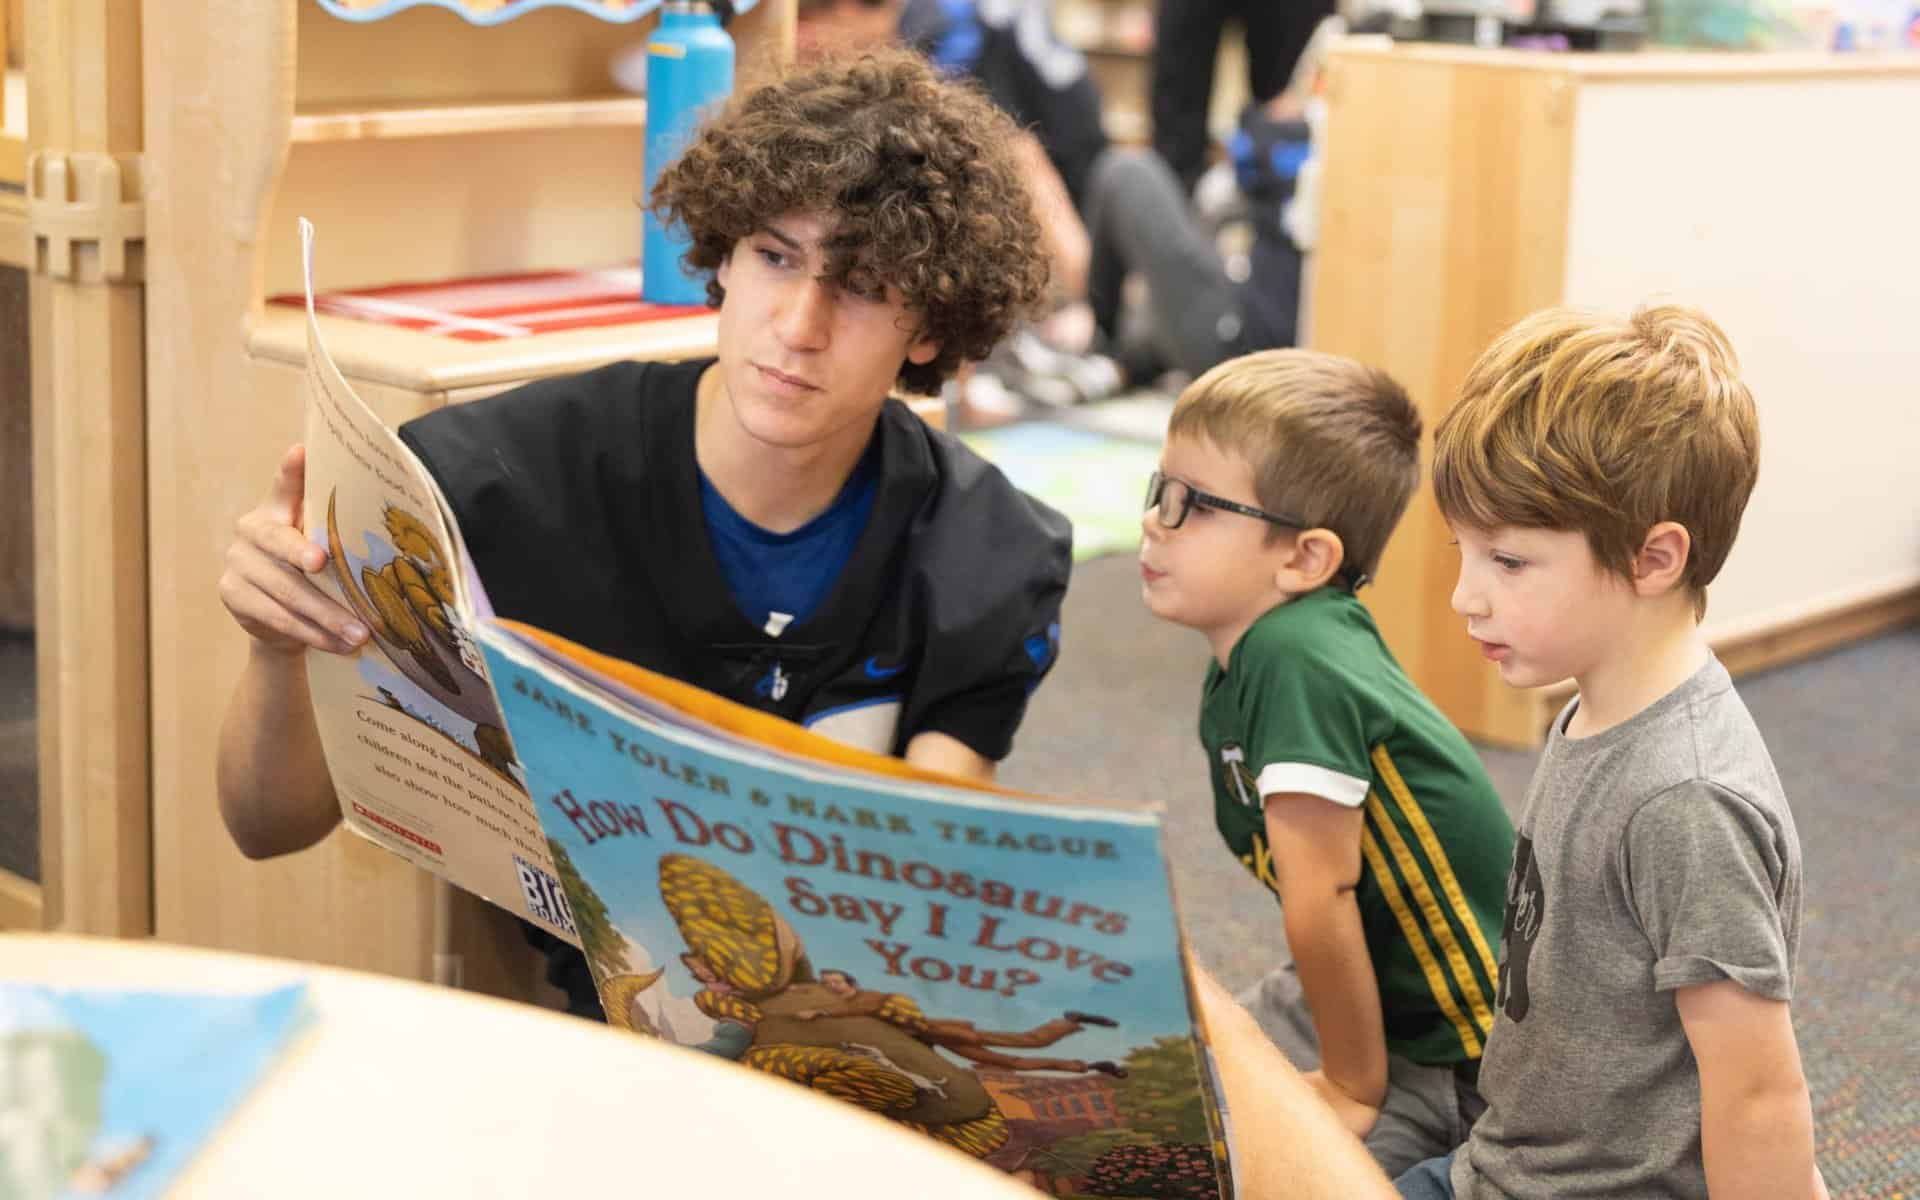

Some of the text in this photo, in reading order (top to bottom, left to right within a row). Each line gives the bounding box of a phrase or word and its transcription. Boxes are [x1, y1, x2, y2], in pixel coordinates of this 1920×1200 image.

[356, 710, 397, 735] Come
[400, 732, 438, 759] along
[440, 752, 464, 773] and
[466, 767, 493, 791] join
[496, 786, 517, 807] the
[356, 733, 412, 767] children
[415, 761, 440, 781] test
[442, 775, 464, 792] the
[466, 789, 521, 826] patience
[514, 675, 597, 736] JANE
[608, 728, 731, 797] YOLEN
[785, 792, 915, 836] MARK
[932, 819, 1121, 861] TEAGUE
[374, 761, 401, 782] also
[404, 778, 439, 800] show
[441, 793, 471, 817] how
[475, 814, 512, 841] much
[514, 836, 541, 861] they
[553, 789, 1131, 937] How Do Dinosaurs
[783, 875, 1134, 984] Say I Love
[863, 936, 1041, 998] You?
